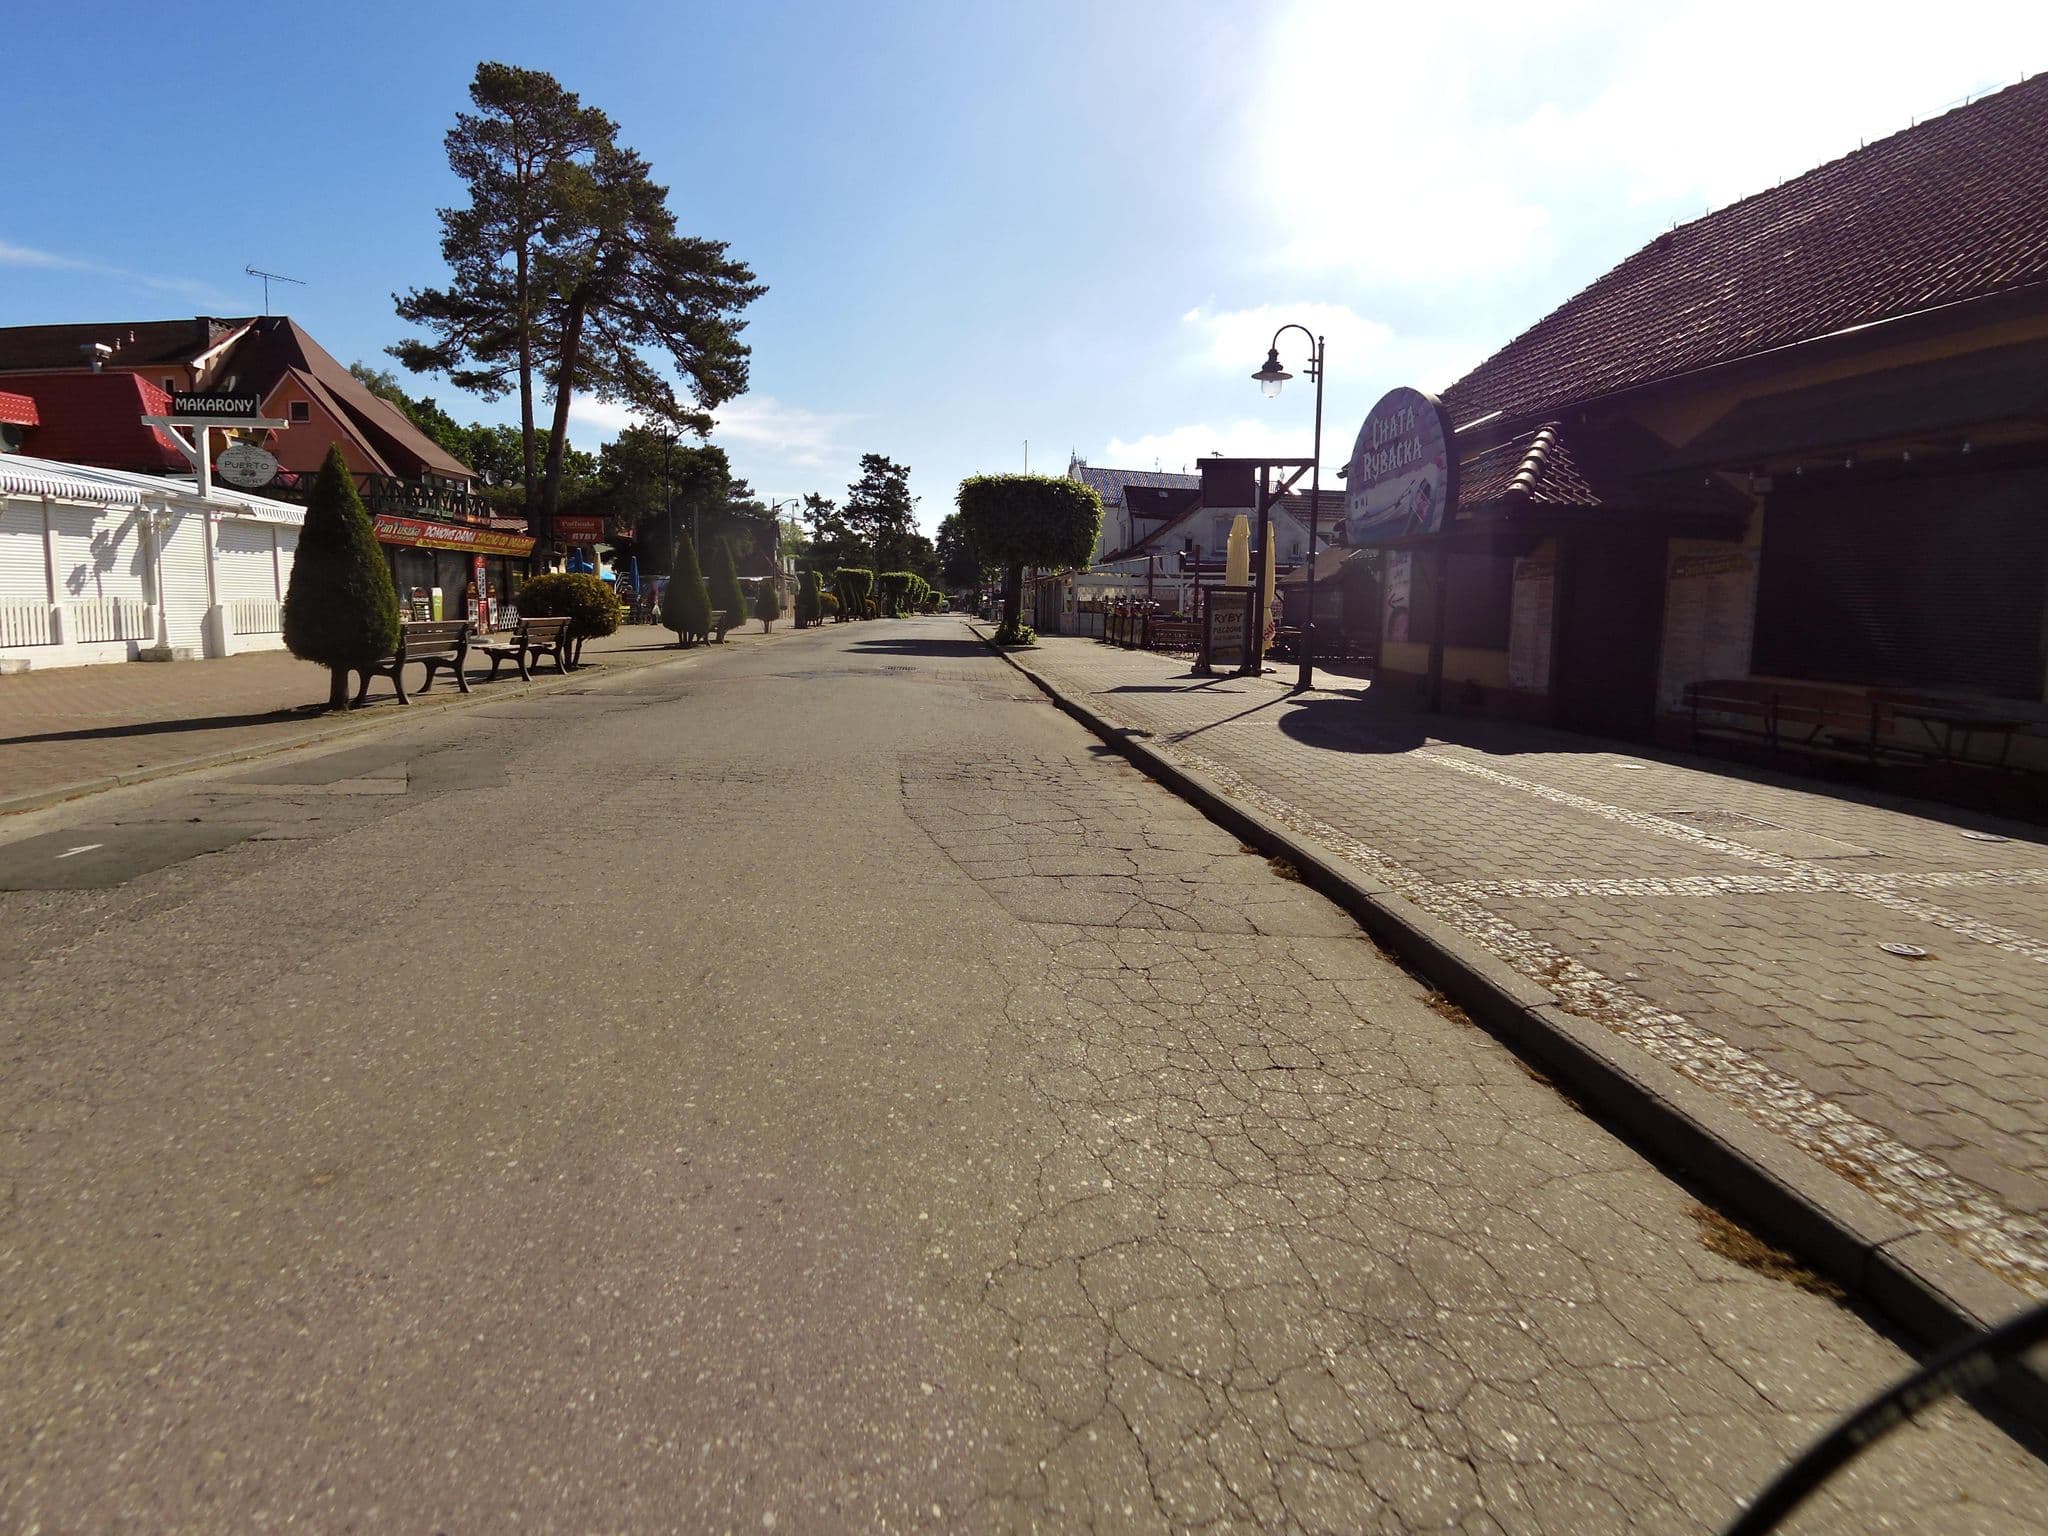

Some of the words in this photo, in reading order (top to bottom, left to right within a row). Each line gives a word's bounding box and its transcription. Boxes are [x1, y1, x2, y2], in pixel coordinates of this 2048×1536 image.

[174, 397, 254, 413] MAKARONY
[1373, 405, 1416, 451] CHATA
[224, 460, 270, 470] PUERTO
[1363, 435, 1422, 482] RYBACKA
[1214, 613, 1243, 623] RYBY
